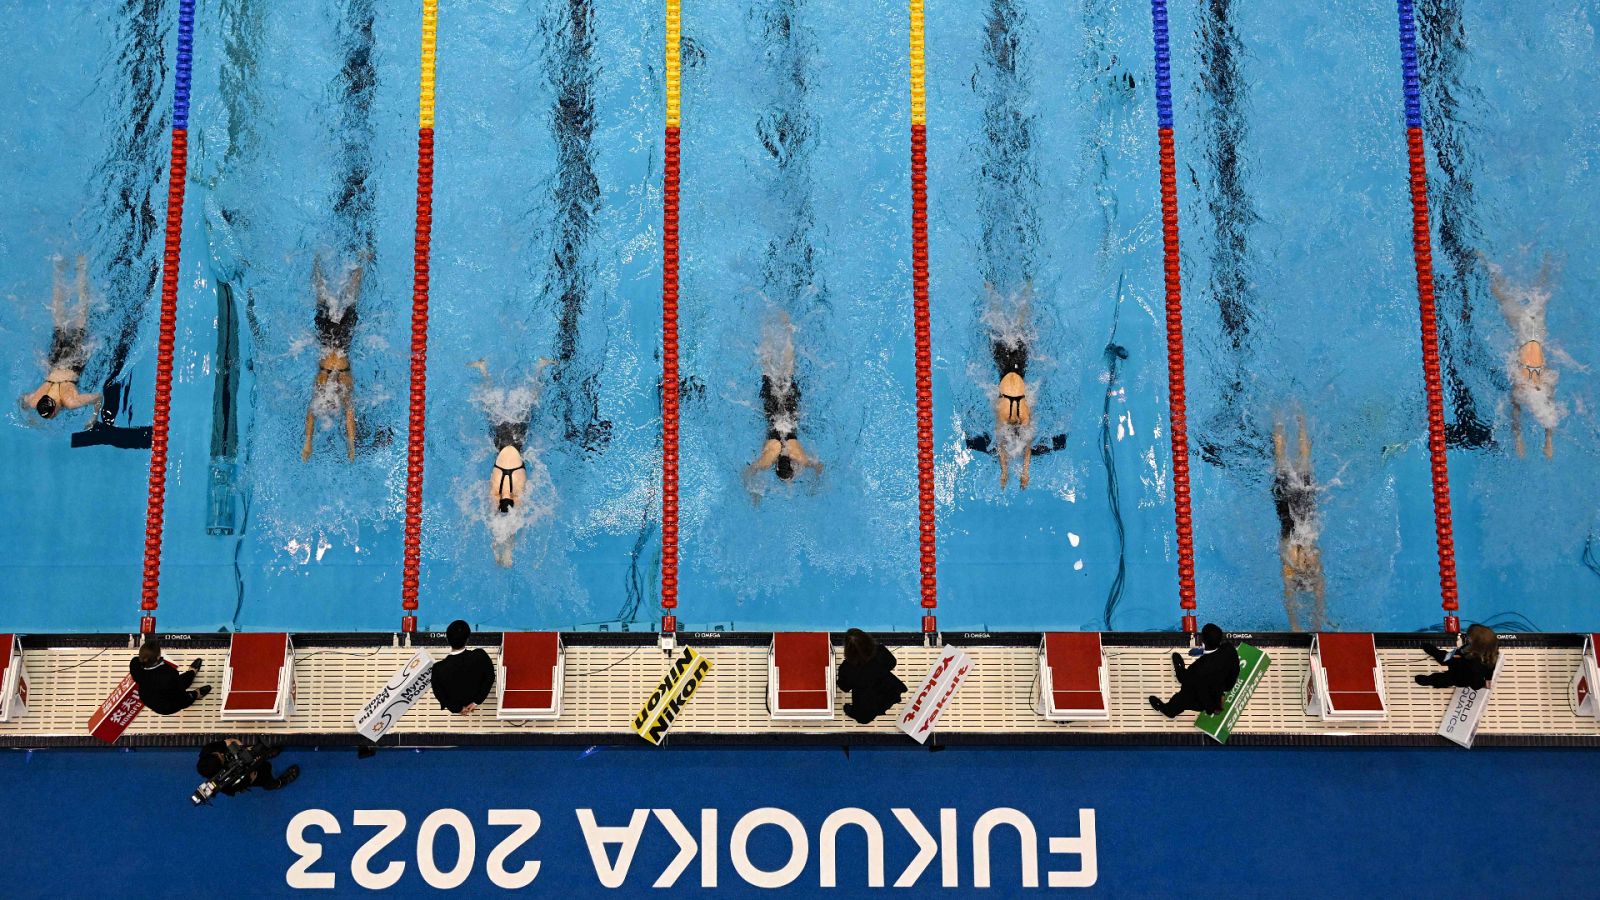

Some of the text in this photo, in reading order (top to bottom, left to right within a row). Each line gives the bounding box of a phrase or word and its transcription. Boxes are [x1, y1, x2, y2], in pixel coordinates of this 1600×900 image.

[358, 692, 390, 724] Myrtha
[364, 688, 387, 711] Pools
[401, 667, 433, 699] Myrtha
[407, 679, 431, 701] Pools
[635, 646, 693, 729] Nikon
[649, 660, 709, 743] Nikon
[903, 655, 955, 724] Yakult
[918, 665, 969, 733] Yakult
[1227, 670, 1263, 732] Salonpas
[1446, 687, 1470, 733] QUATICS
[1459, 689, 1477, 723] ORLD
[286, 808, 1097, 889] FUKUOKA 2023
